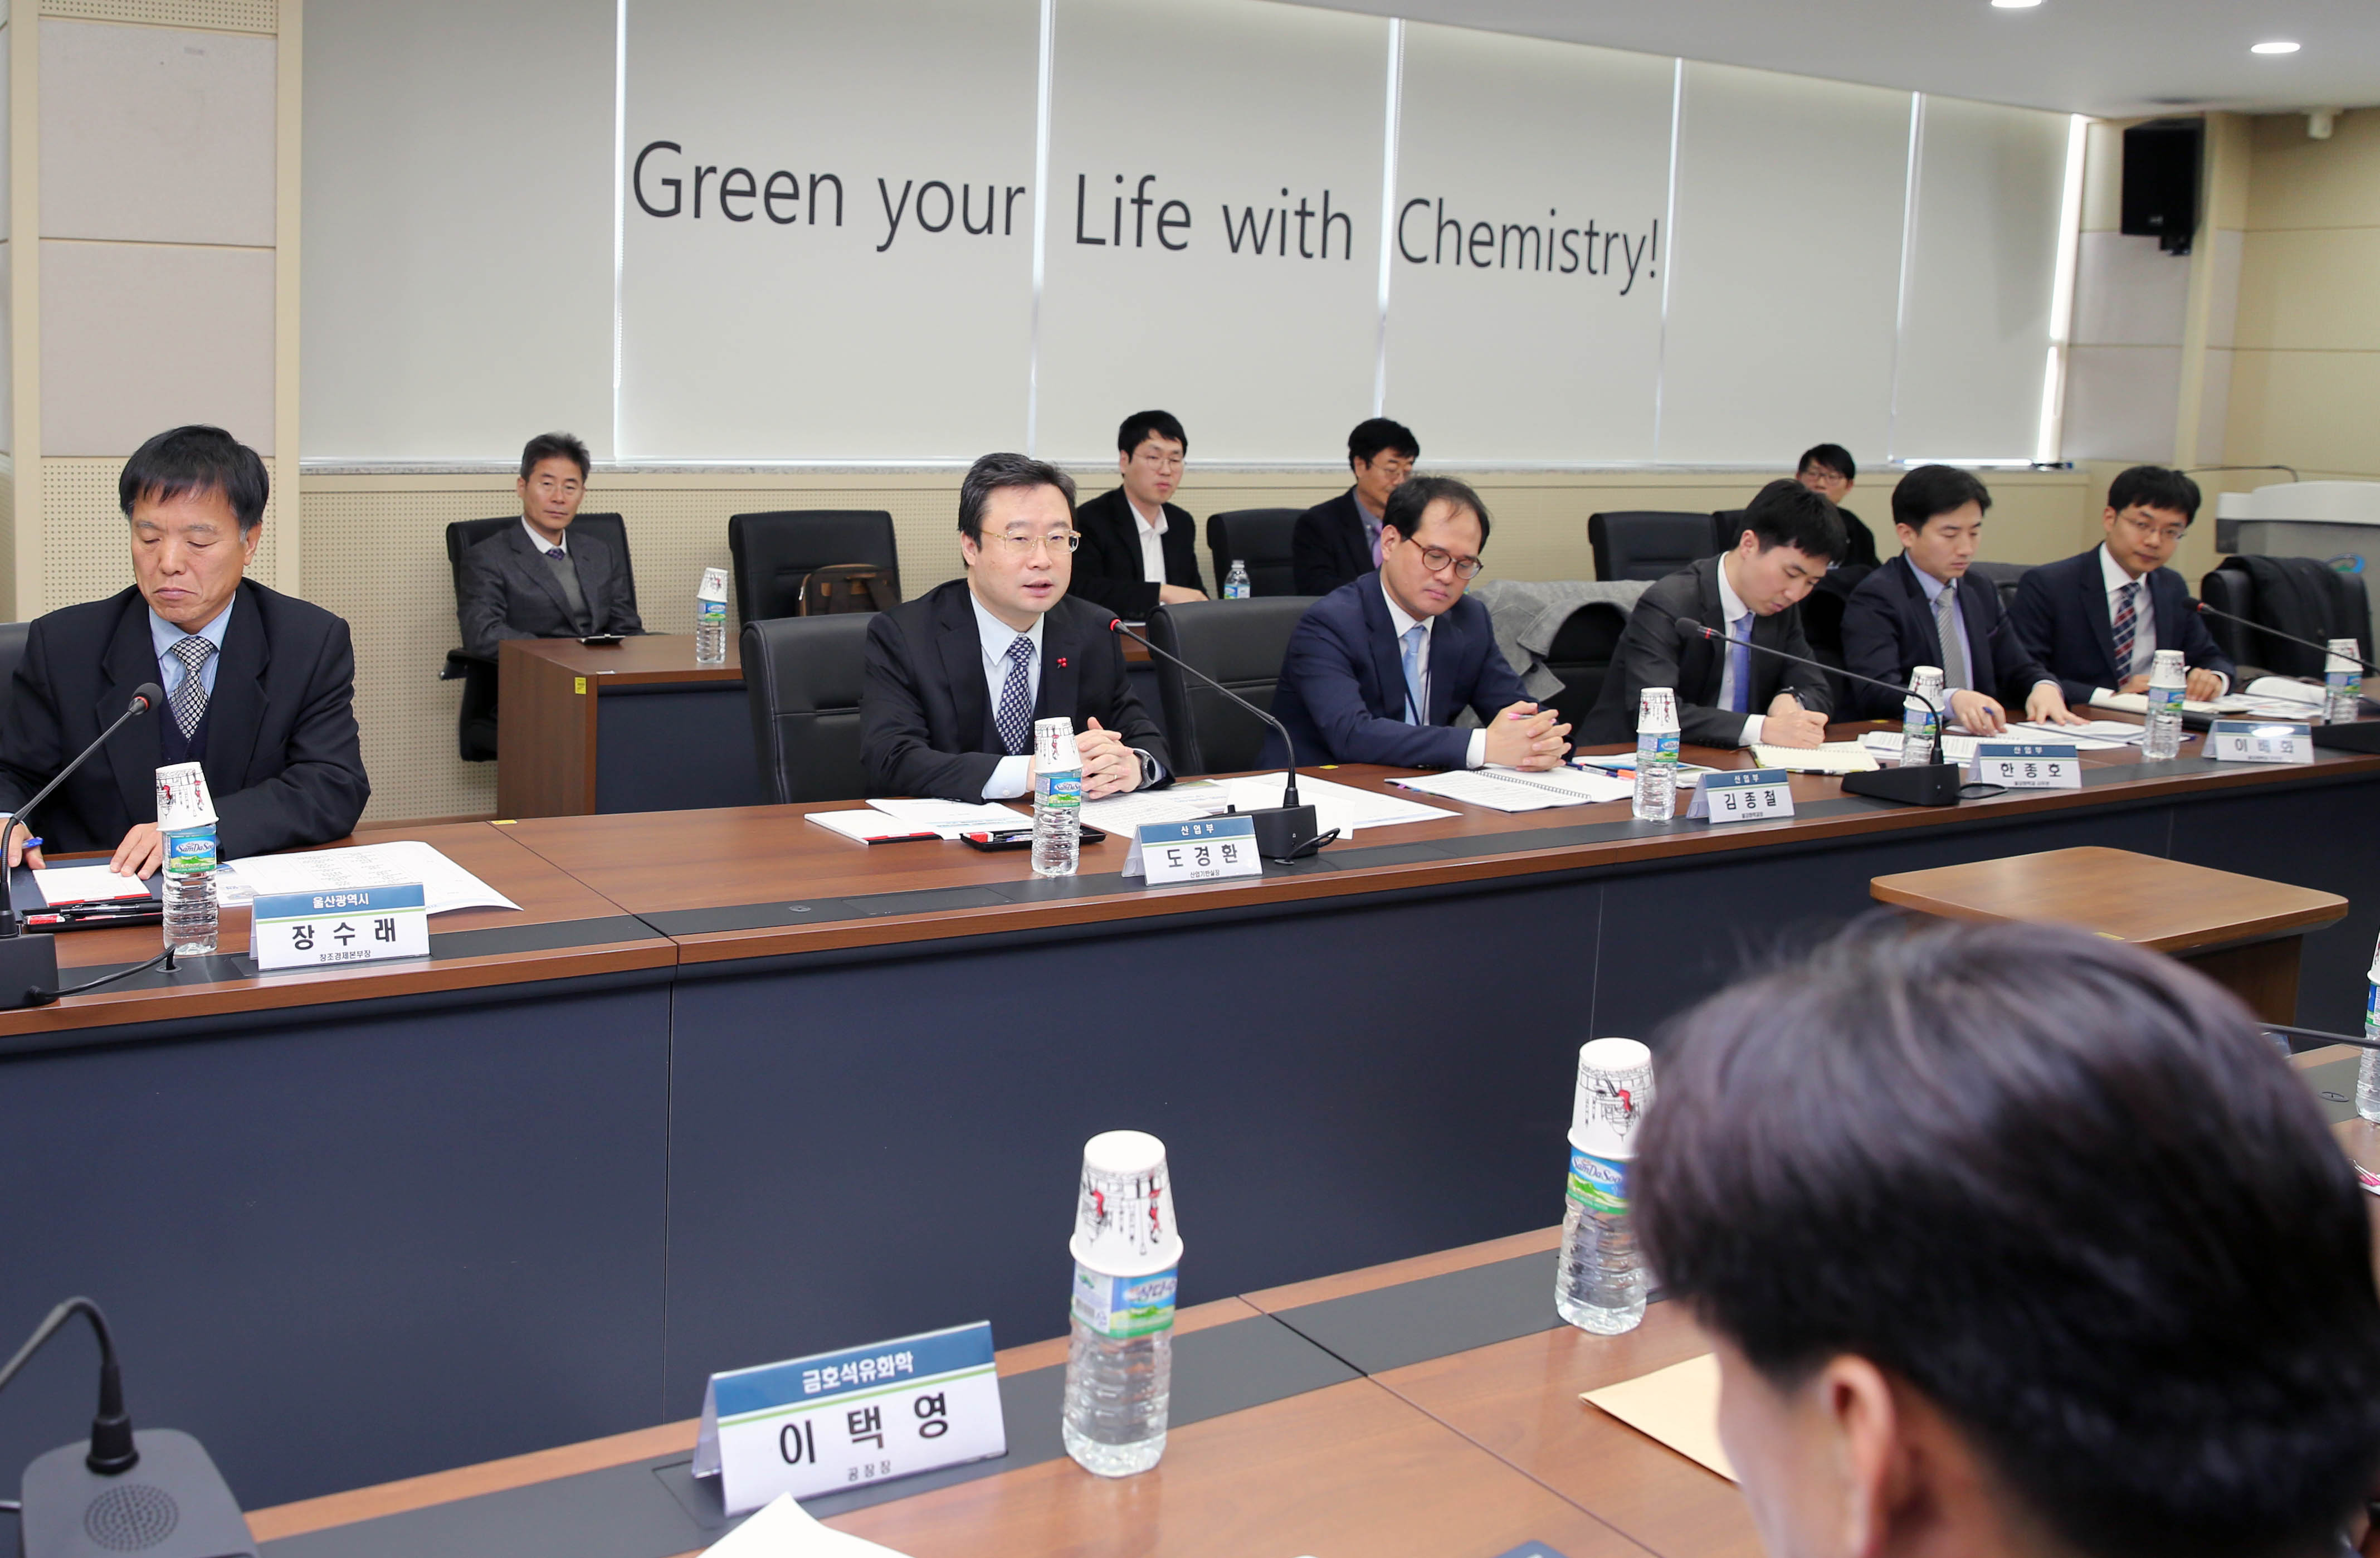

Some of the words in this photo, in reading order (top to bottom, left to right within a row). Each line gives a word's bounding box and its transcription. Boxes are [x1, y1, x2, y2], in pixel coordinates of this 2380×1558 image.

[633, 140, 843, 226] Green
[876, 178, 1026, 252] your
[1076, 174, 1191, 251] Life
[1222, 187, 1352, 260] with
[1398, 197, 1657, 296] Chemistry!
[1189, 869, 1220, 878] 산업기반실장
[313, 893, 369, 909] 울산광역시
[319, 950, 371, 962] 창조경제본부장
[802, 1350, 914, 1395] 금호석유화학
